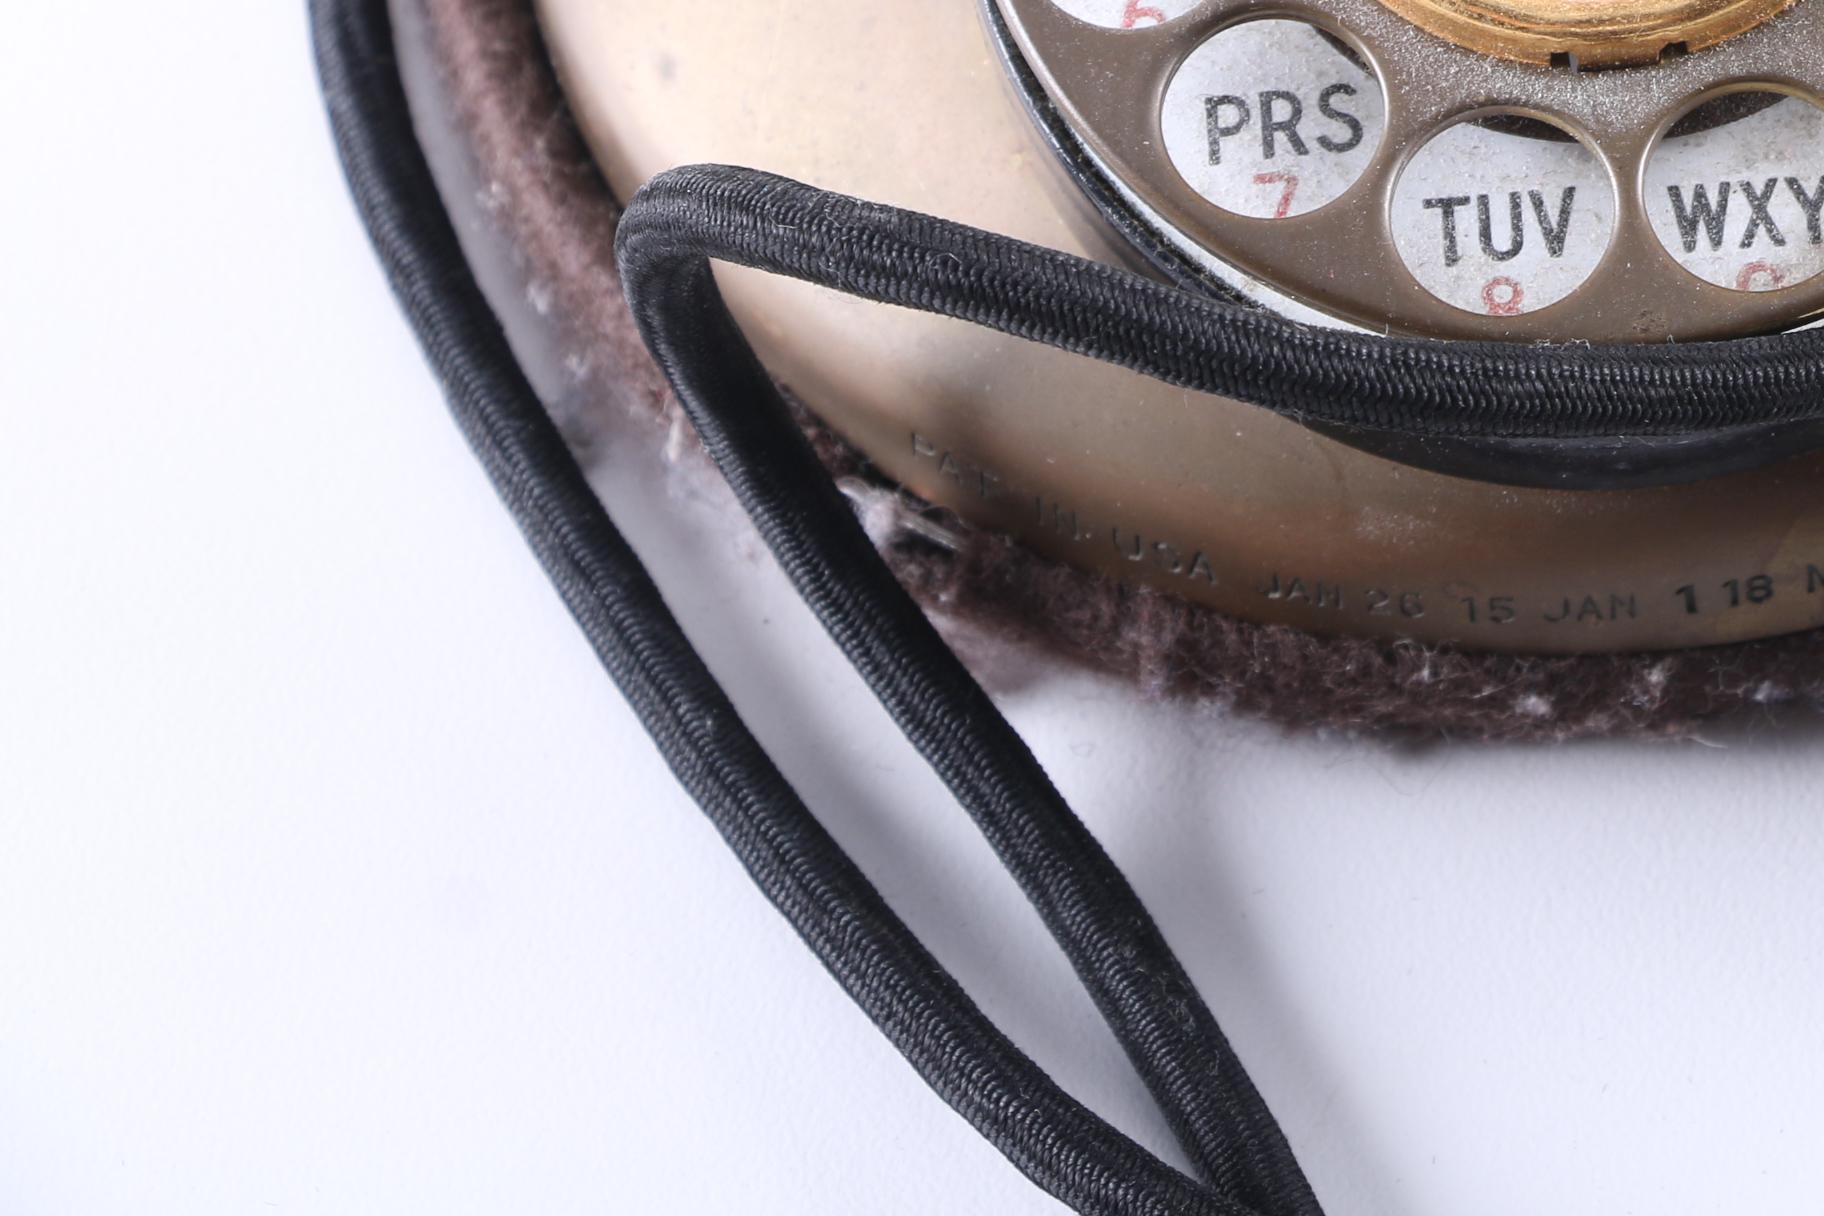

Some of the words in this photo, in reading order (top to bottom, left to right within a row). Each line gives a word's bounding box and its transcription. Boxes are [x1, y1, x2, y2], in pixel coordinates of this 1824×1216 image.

[1204, 83, 1365, 166] PRS
[1252, 171, 1299, 219] 7
[1422, 185, 1577, 267] TUV
[1461, 595, 1518, 624] 15
[1543, 593, 1637, 623] JAN
[1721, 574, 1774, 607] 18
